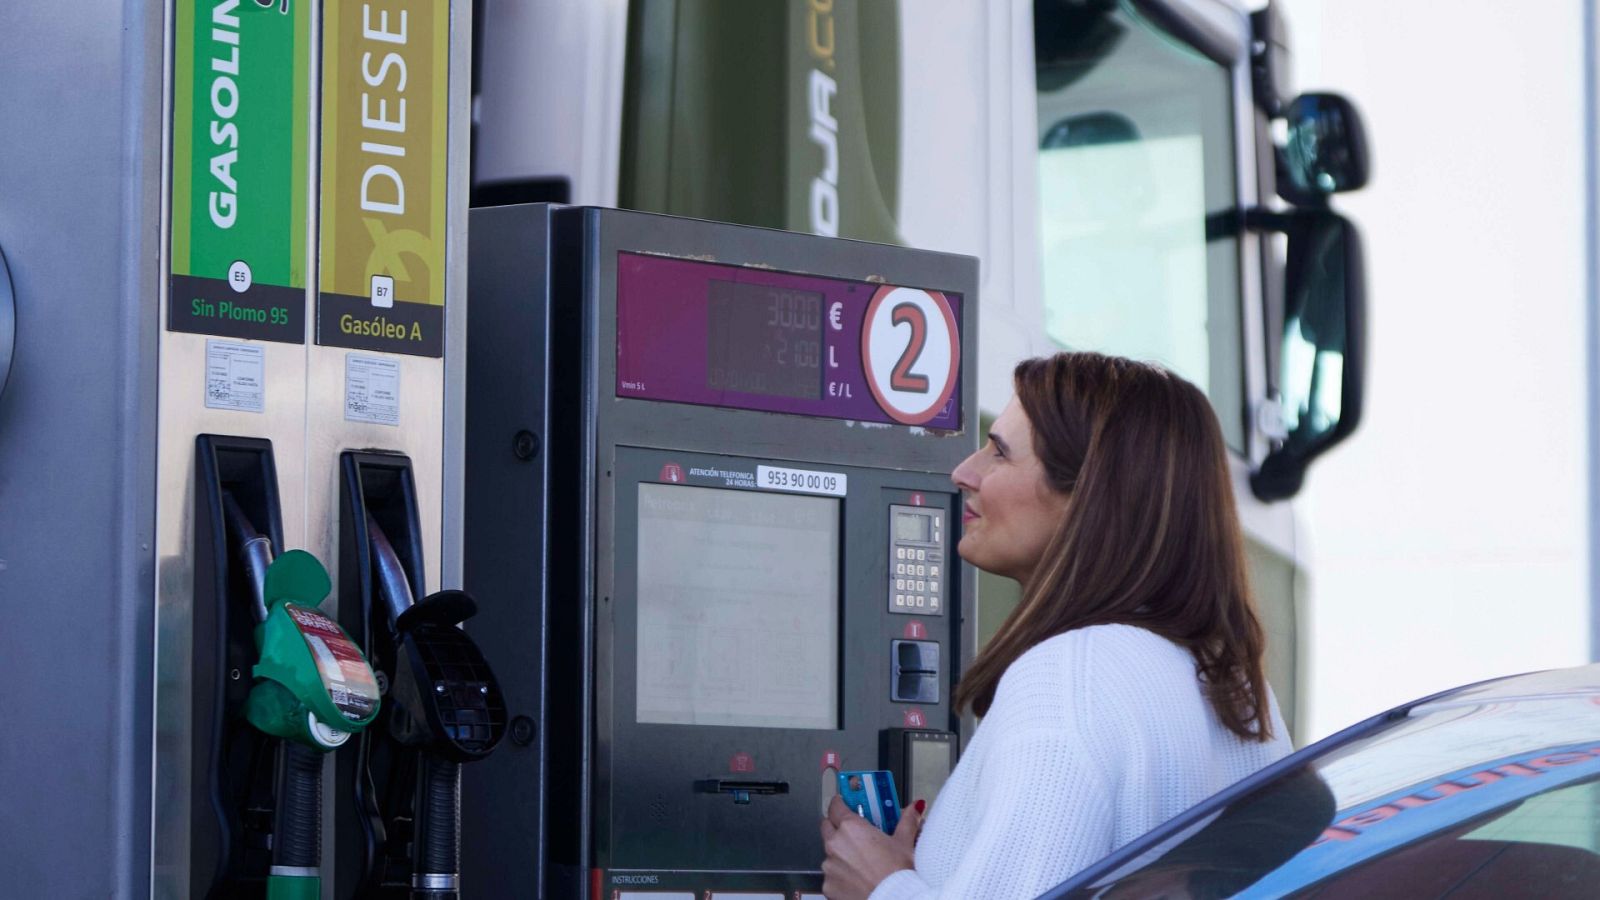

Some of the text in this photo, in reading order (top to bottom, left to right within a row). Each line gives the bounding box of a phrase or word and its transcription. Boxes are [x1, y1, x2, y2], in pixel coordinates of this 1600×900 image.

[208, 0, 240, 229] GASOLIN
[360, 3, 408, 215] DIESE
[234, 271, 246, 282] E5
[376, 286, 388, 297] B7
[191, 299, 289, 325] Sin Plomo 95
[829, 301, 843, 330] €
[340, 313, 423, 341] Gasóleo A
[829, 345, 839, 368] L
[889, 301, 930, 394] 2
[689, 467, 754, 480] ATENCIÓN TELEFONICA
[725, 478, 734, 486] 24
[767, 470, 837, 491] 953 90 00 09
[612, 875, 659, 884] INSTRUCCIONES
